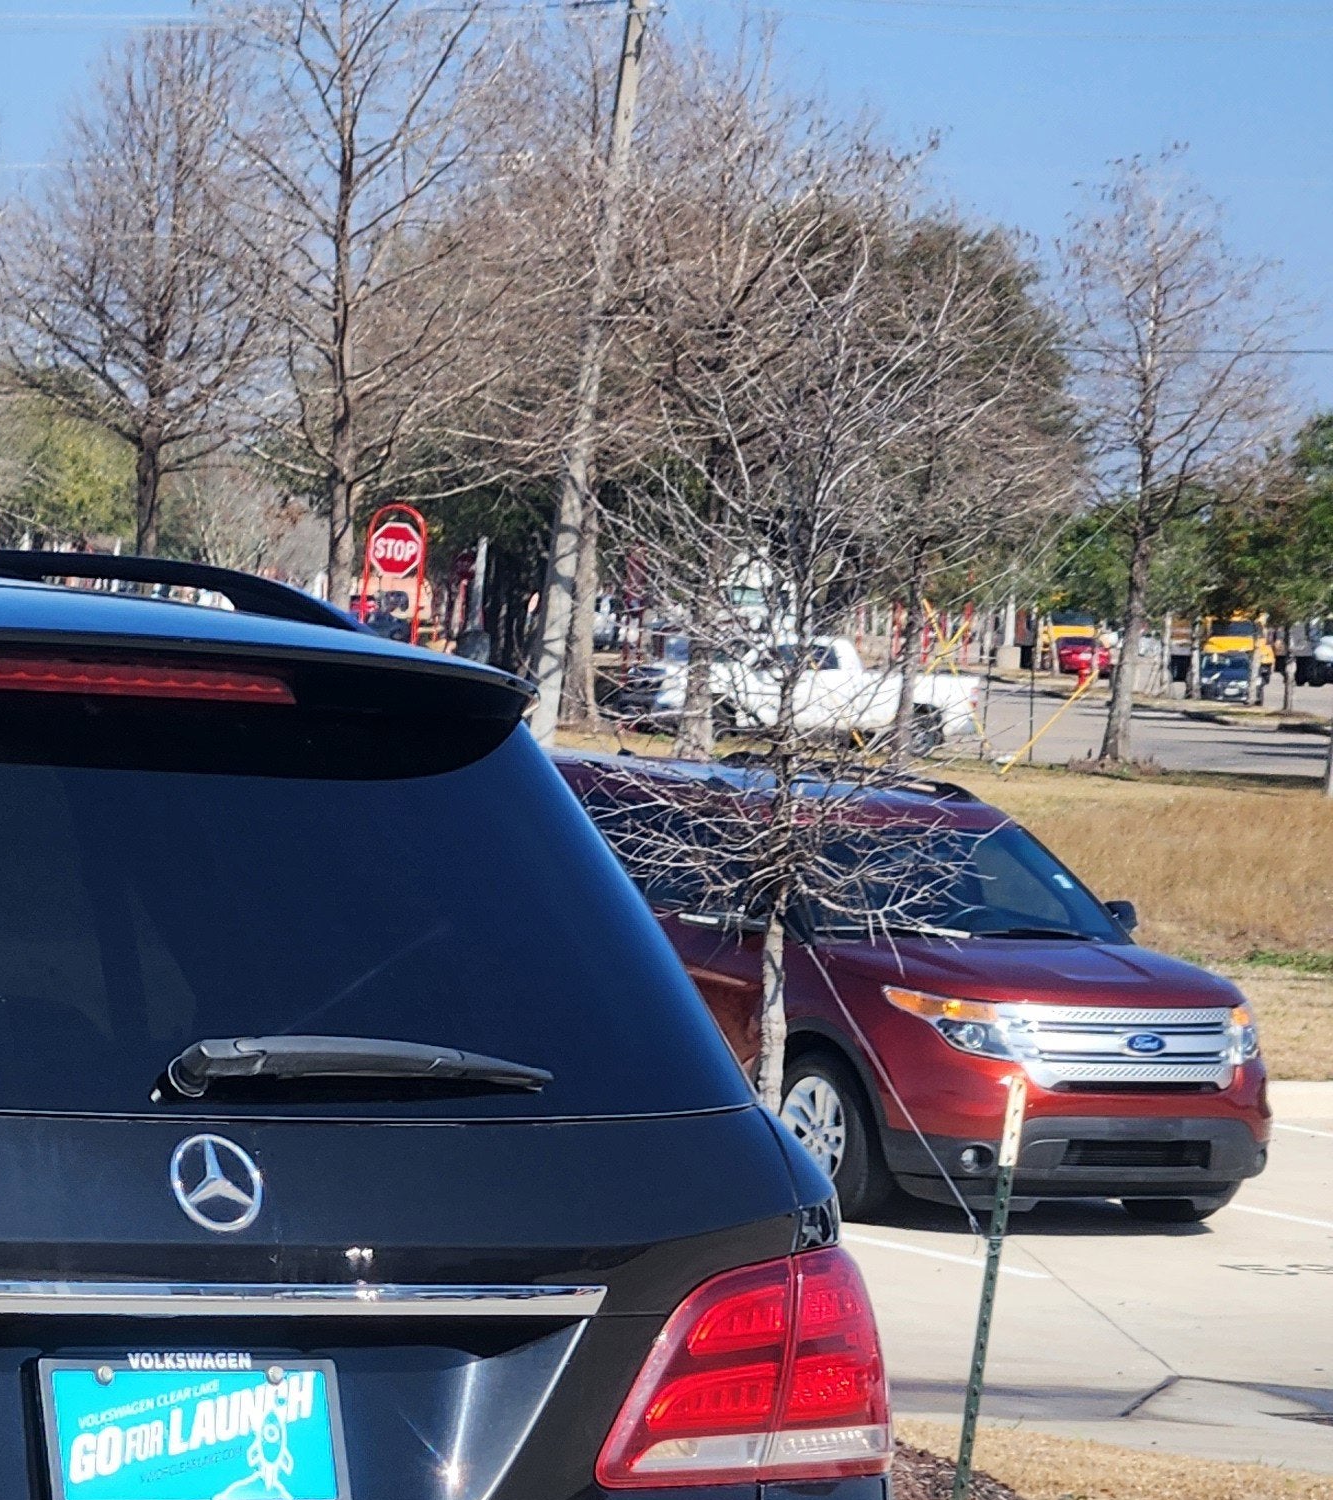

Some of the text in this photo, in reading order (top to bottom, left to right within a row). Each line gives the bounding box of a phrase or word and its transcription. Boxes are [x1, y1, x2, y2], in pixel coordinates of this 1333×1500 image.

[374, 537, 418, 562] STOP
[127, 1352, 252, 1370] VOLKSWAGEN
[77, 1397, 154, 1430] VOLKSWAGEN
[156, 1386, 191, 1408] CLEAR
[69, 1371, 316, 1484] GO FOR LAUNCH
